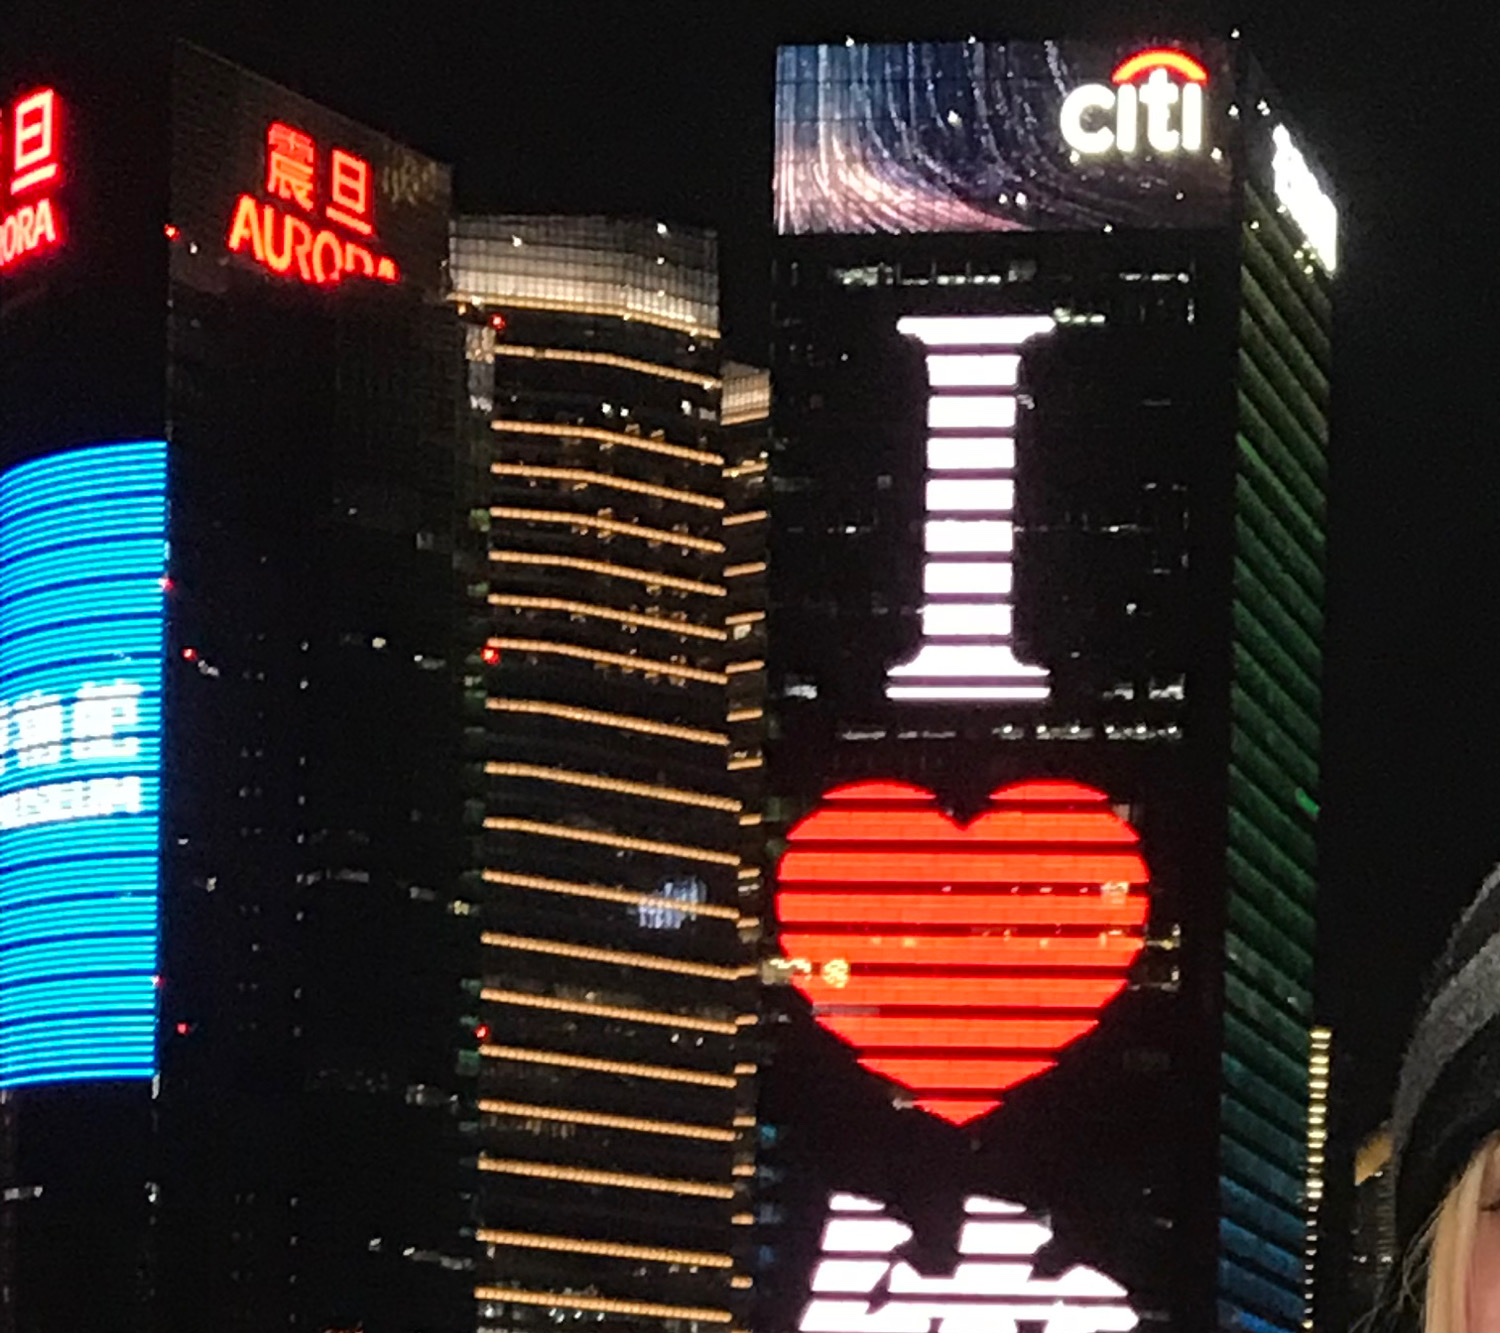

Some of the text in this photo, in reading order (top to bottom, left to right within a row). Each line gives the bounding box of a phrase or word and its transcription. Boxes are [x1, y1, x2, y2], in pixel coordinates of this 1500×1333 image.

[0, 88, 58, 195] 旦
[1060, 67, 1203, 154] citi
[0, 197, 56, 267] ORA
[267, 122, 373, 236] 震旦
[885, 316, 1056, 700] I
